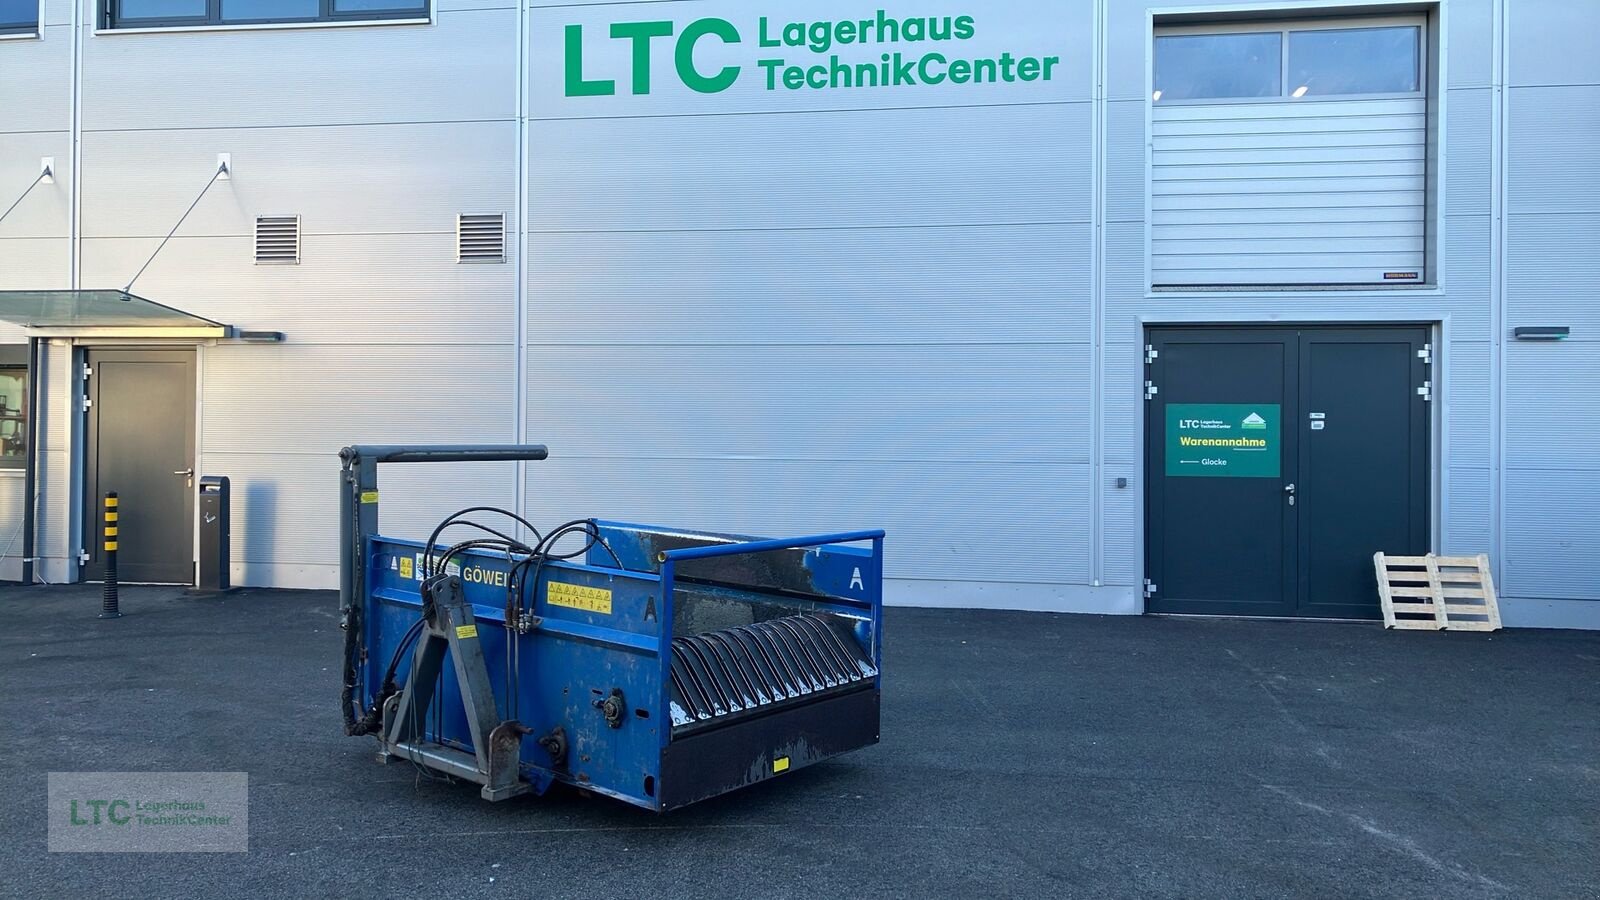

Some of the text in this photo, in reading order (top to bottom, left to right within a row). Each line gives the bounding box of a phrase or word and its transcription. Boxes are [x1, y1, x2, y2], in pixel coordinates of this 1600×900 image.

[757, 8, 976, 54] Lagerhaus
[563, 16, 742, 97] LTC
[756, 49, 1061, 91] TechnikCenter
[1179, 419, 1200, 429] LTC
[1180, 436, 1266, 447] Warenannahme
[1201, 458, 1227, 466] Glocke
